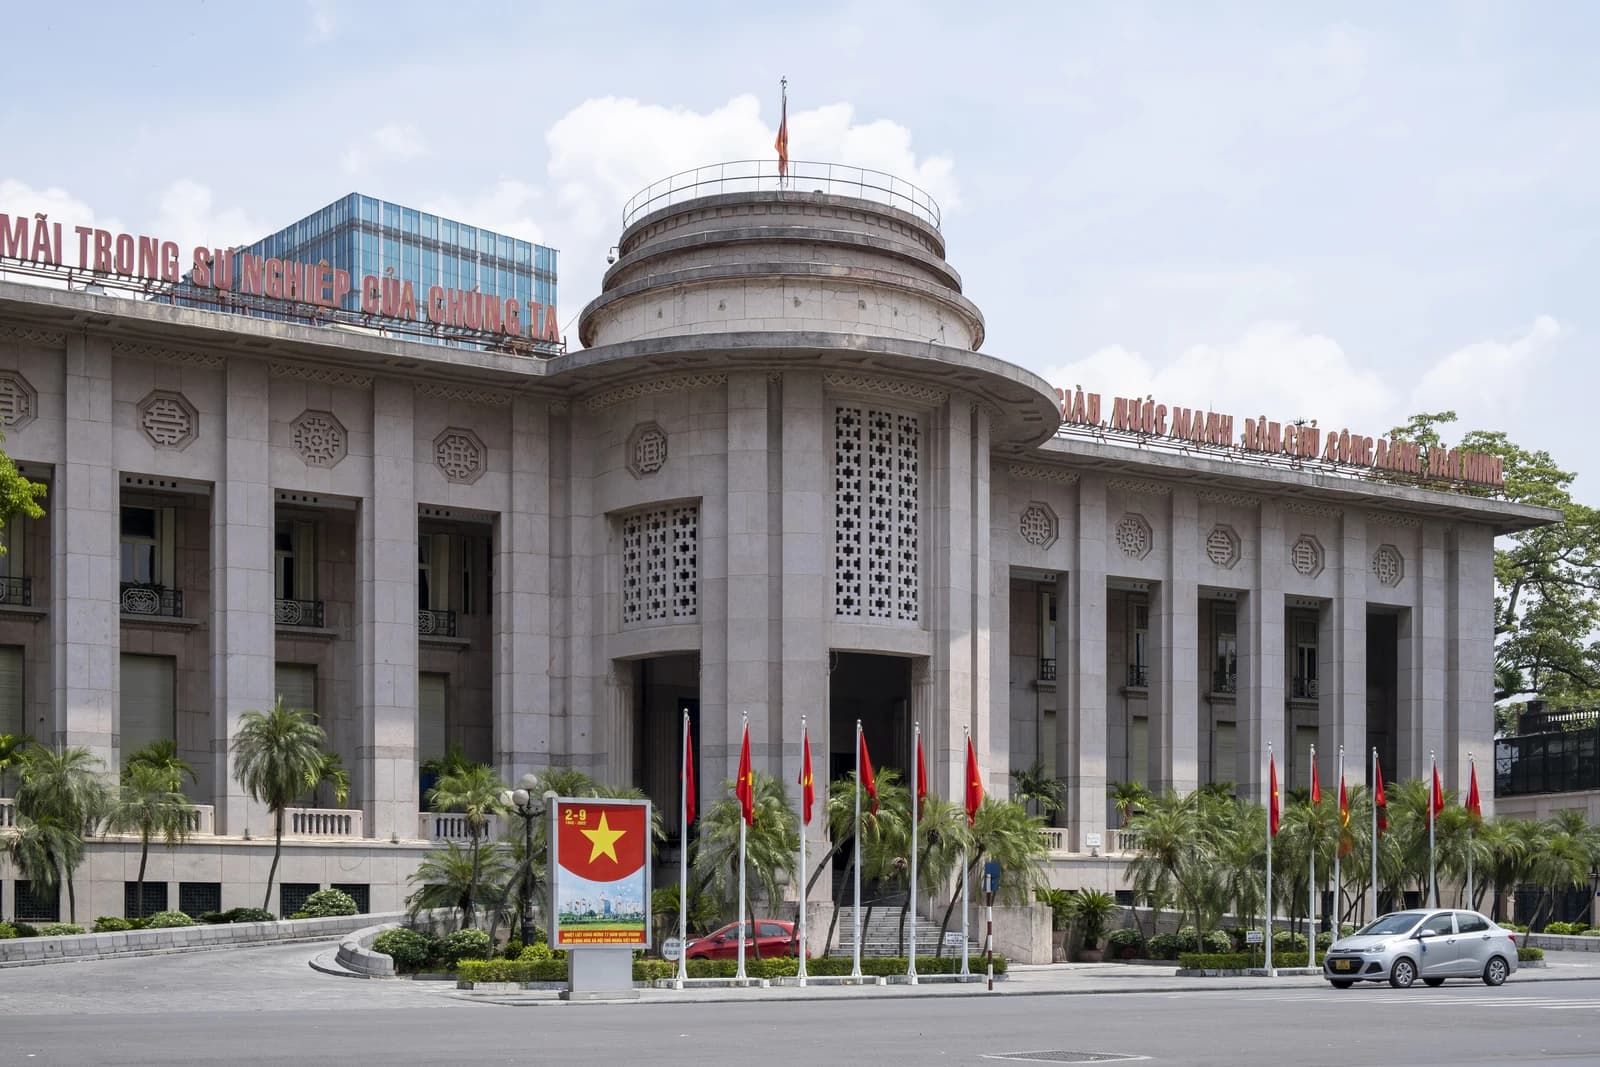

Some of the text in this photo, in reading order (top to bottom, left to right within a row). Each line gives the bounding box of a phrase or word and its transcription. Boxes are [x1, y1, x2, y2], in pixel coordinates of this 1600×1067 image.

[0, 212, 560, 343] MÃI TRONG SỰ NGHIỆP CỦA CHÚNG TA
[1113, 394, 1168, 435] NƯỚC
[1326, 428, 1374, 466] CÔNG
[565, 808, 587, 821] 2-9
